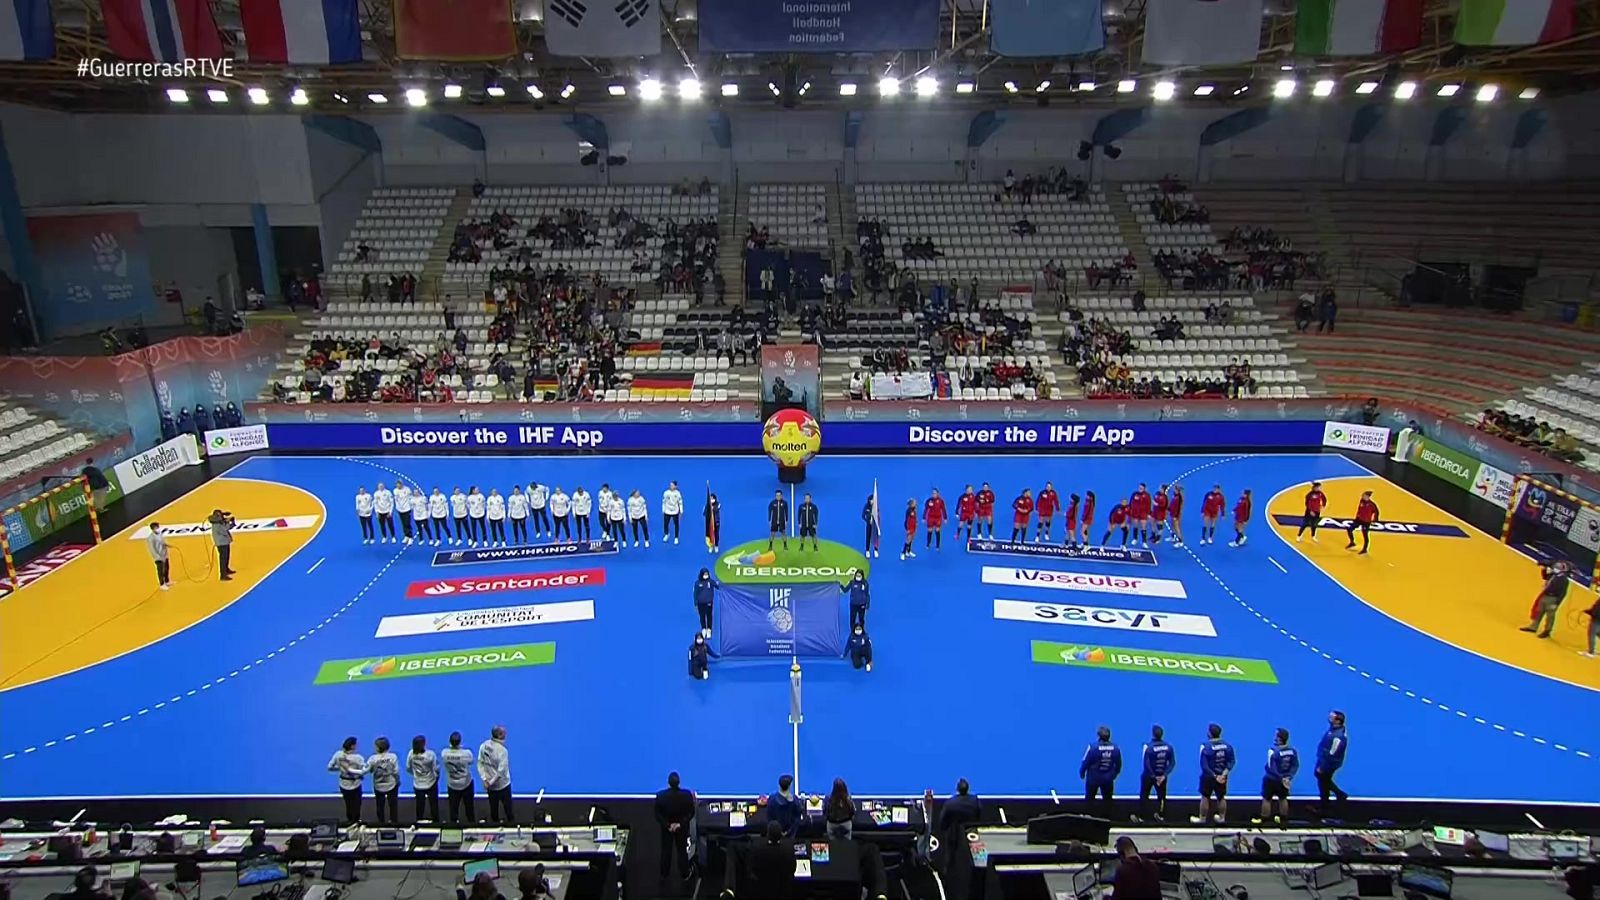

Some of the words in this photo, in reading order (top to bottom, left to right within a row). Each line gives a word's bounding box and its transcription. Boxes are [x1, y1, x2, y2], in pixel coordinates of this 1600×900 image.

[381, 427, 469, 444] Discover
[474, 427, 507, 444] the
[519, 427, 555, 444] IHF
[561, 427, 603, 447] App
[909, 426, 999, 442] Discover
[1004, 426, 1037, 442] the
[1050, 425, 1086, 442] IHF
[1091, 426, 1134, 445] App
[772, 443, 807, 452] molten
[1421, 449, 1470, 480] IBERDROLA
[735, 567, 857, 576] IBERDROLA
[1015, 568, 1142, 589] iVascular
[460, 575, 589, 593] Santander
[769, 588, 791, 608] IHF
[456, 610, 534, 621] COMUNITAT
[460, 619, 478, 627] DE
[482, 614, 543, 626] L'ESPORT
[1034, 605, 1168, 628] sacyr
[400, 650, 526, 671] IBERDROLA
[1110, 653, 1244, 675] IBERDROLA
